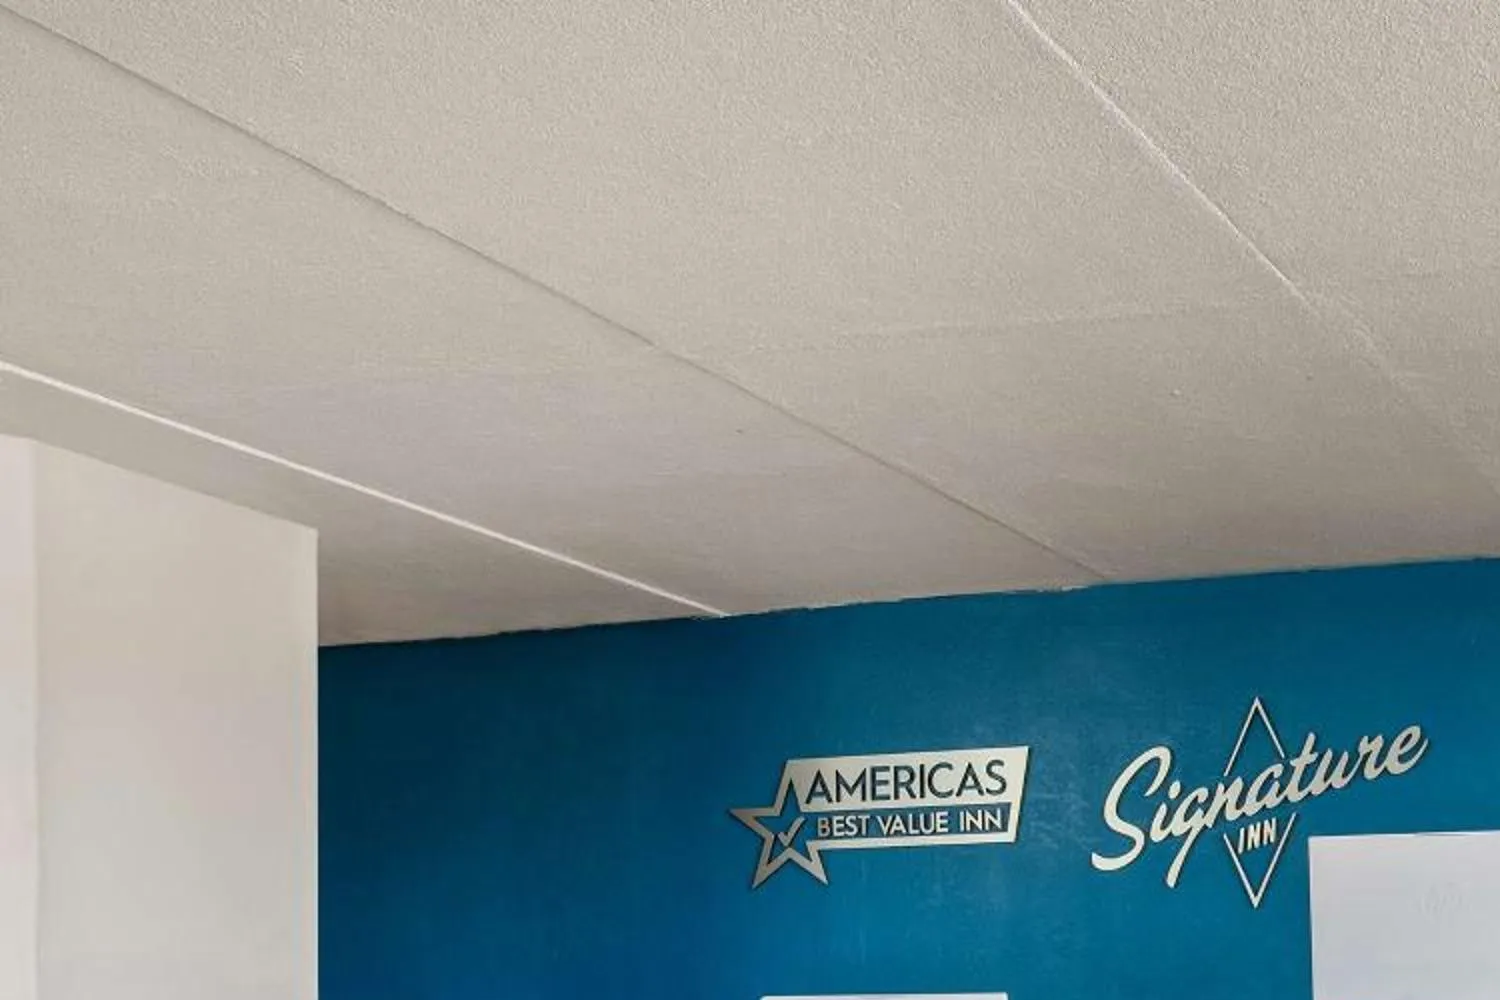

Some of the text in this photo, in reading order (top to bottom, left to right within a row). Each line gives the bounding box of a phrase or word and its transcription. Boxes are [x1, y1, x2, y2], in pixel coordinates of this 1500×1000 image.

[805, 759, 1007, 804] AMERICAS
[818, 808, 1003, 837] BEST VALUE INN
[1091, 725, 1429, 889] Signature
[1238, 818, 1278, 854] INN
